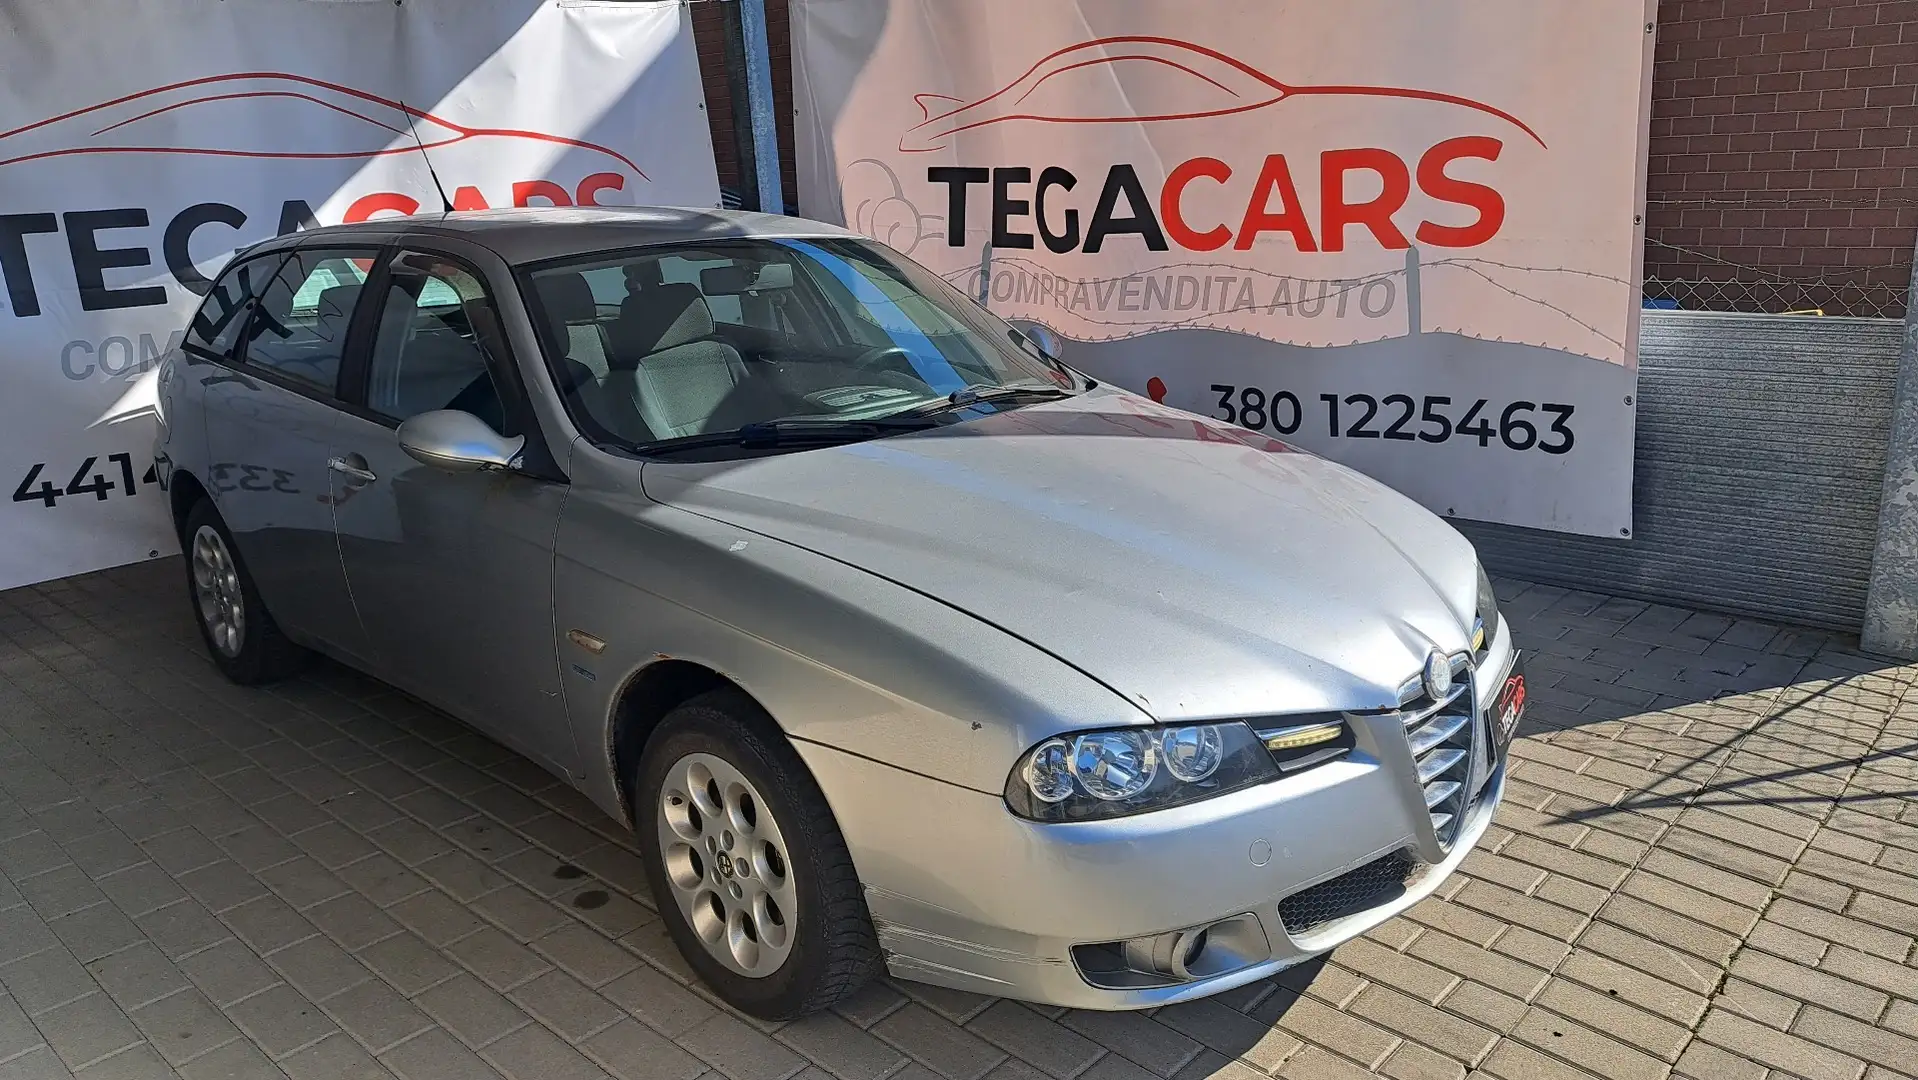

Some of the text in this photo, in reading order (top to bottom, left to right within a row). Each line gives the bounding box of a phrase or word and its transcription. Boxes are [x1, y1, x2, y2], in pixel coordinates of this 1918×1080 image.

[928, 136, 1505, 254] TEGACARS
[968, 268, 1396, 319] COMPRAVENDITA AUTO
[1209, 384, 1576, 455] 380 1225463
[12, 452, 158, 508] 441
